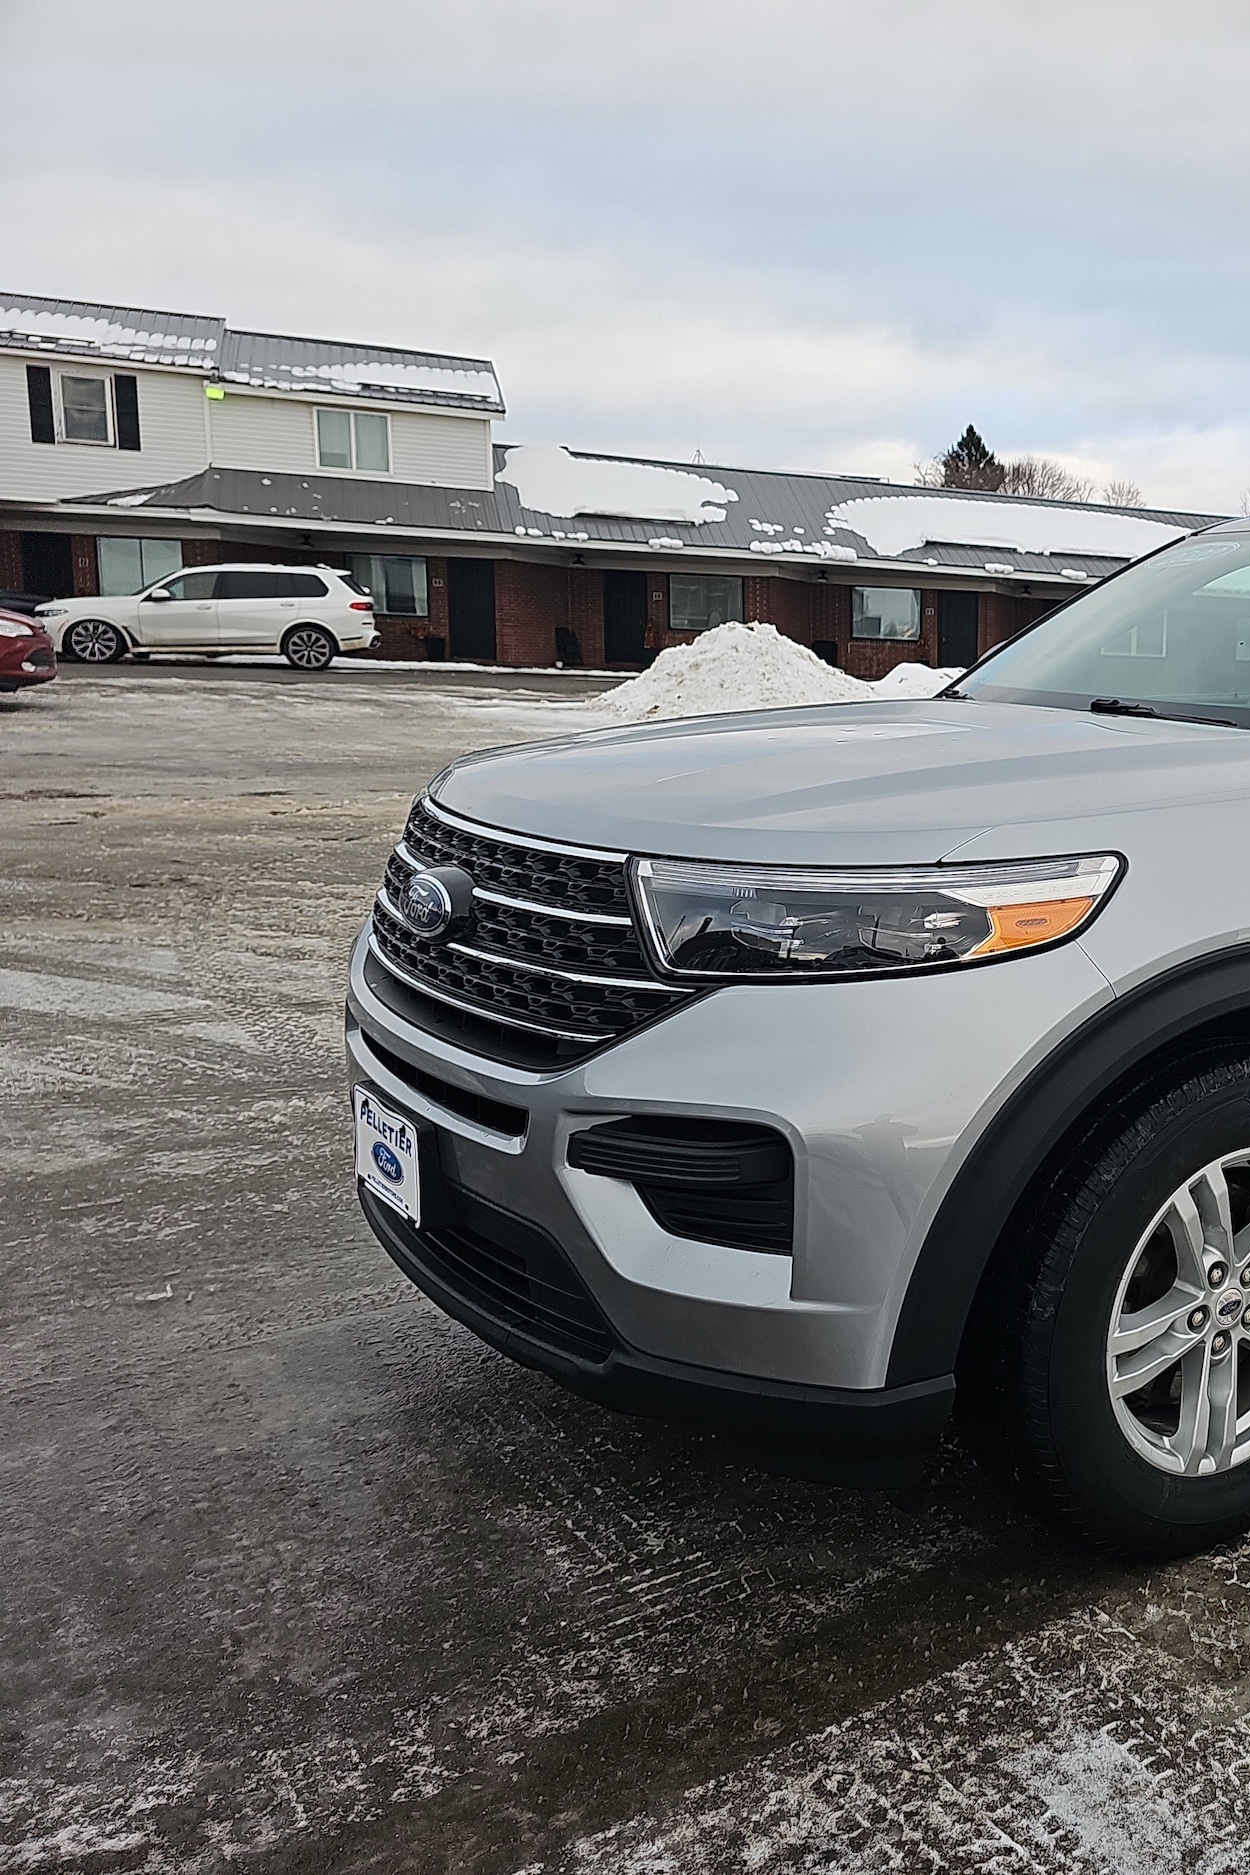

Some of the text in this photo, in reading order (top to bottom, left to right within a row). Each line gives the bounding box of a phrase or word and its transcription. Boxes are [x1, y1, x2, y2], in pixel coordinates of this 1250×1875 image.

[403, 885, 435, 924] Ford
[983, 882, 1088, 900] EXPLORER
[360, 1104, 412, 1158] PELLETIER
[377, 1147, 397, 1178] Ford
